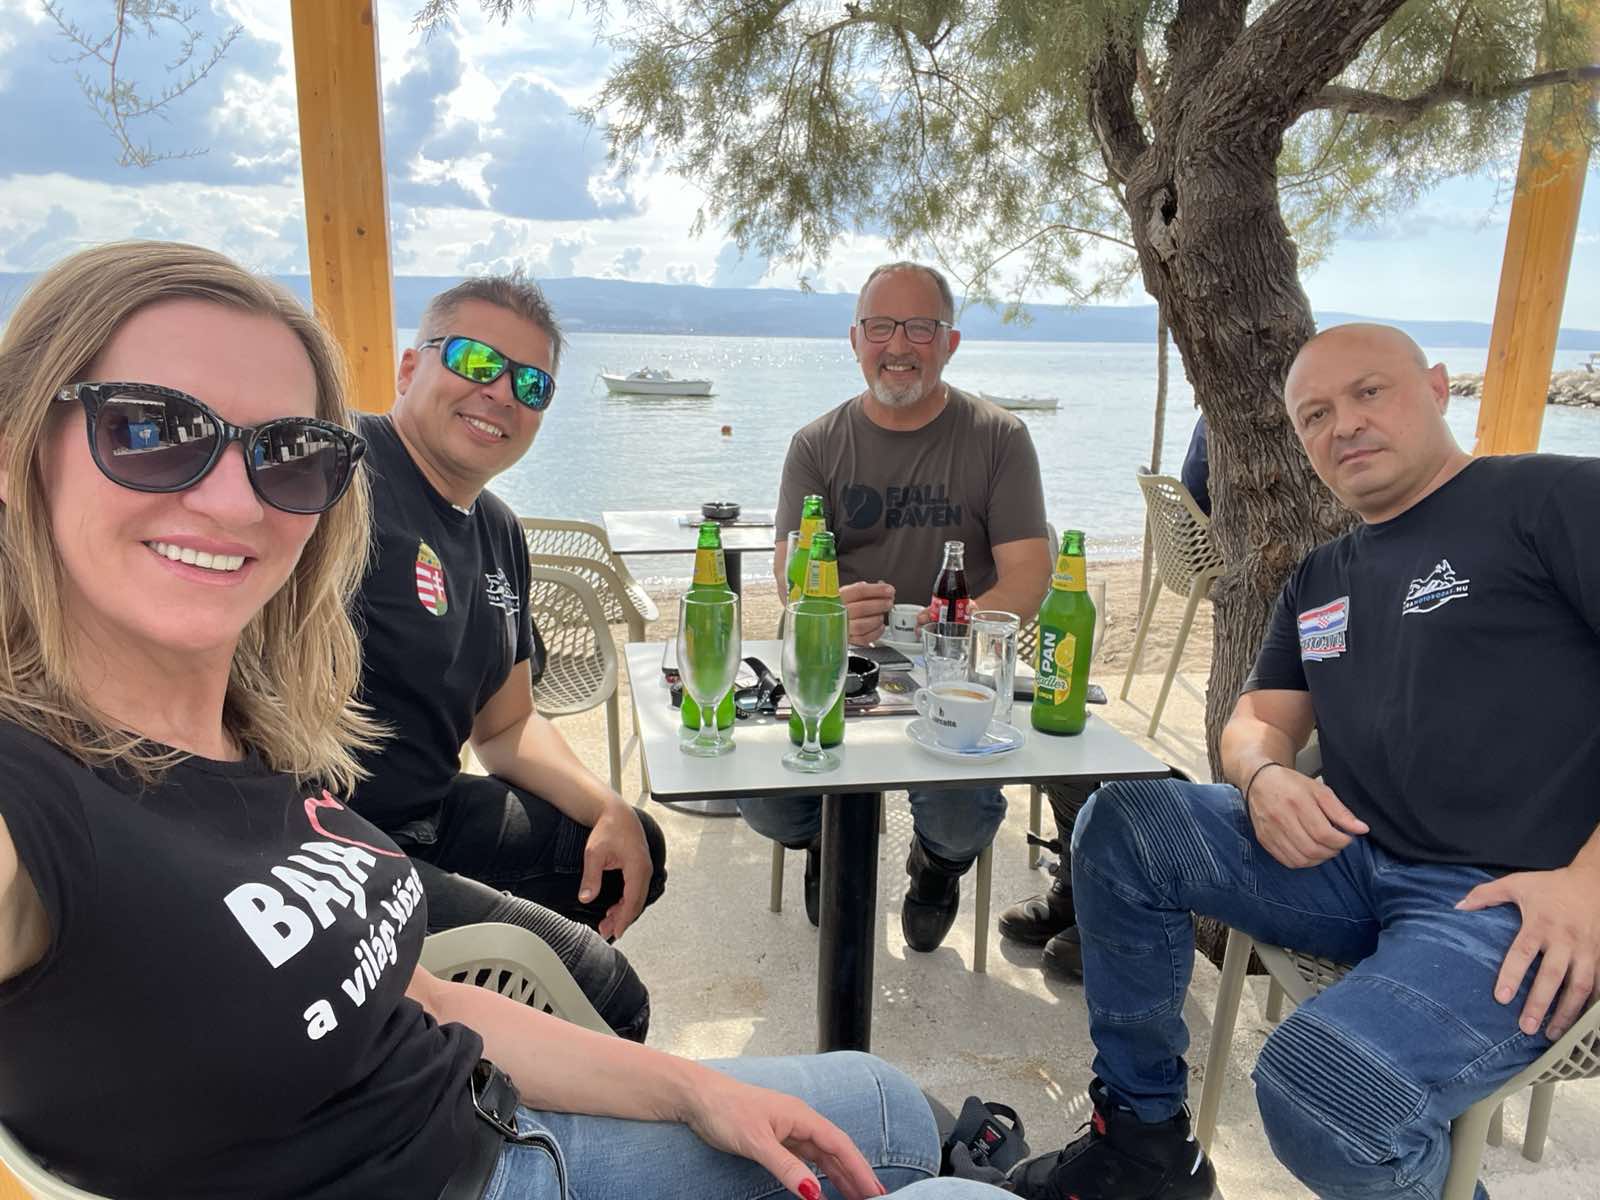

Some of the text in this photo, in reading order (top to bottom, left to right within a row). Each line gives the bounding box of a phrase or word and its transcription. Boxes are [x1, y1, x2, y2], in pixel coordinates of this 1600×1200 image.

[1041, 631, 1057, 673] PAN
[223, 841, 376, 968] BAJA
[303, 999, 338, 1040] a
[341, 919, 398, 1007] világ
